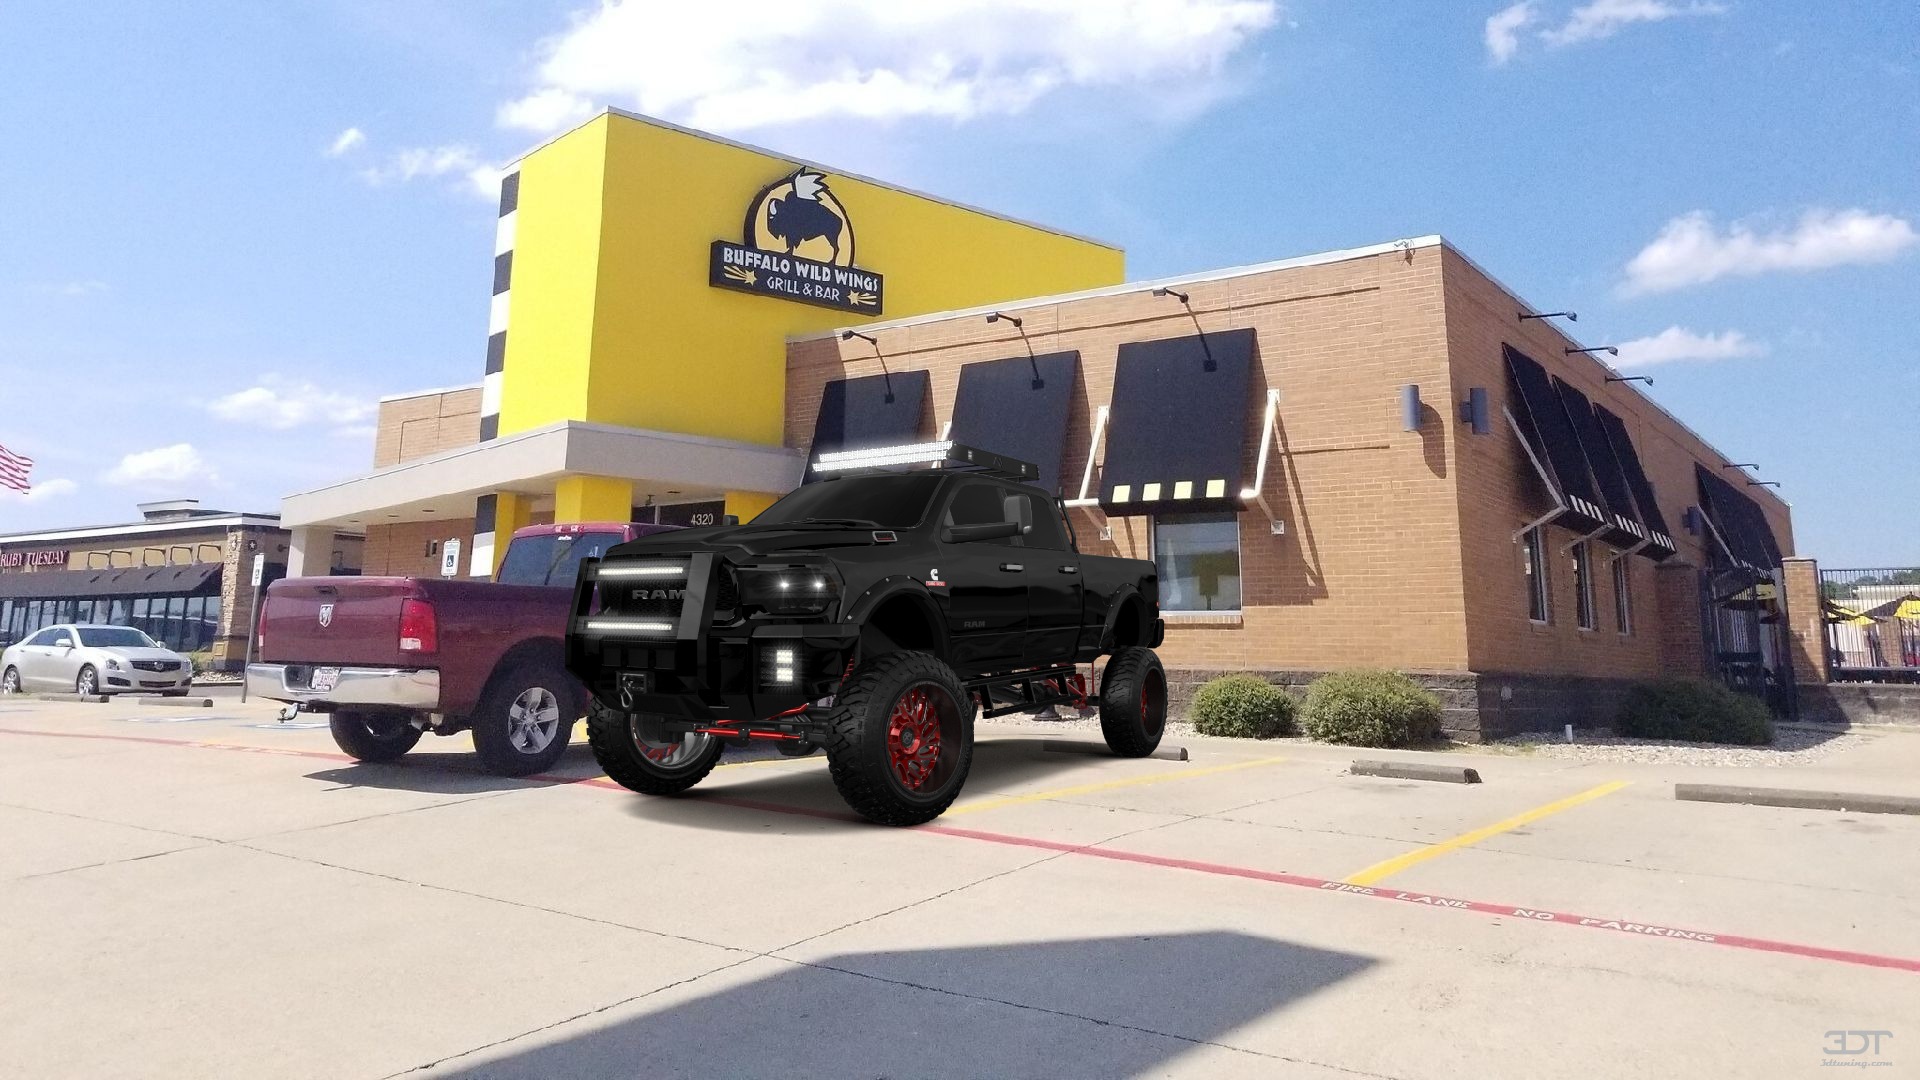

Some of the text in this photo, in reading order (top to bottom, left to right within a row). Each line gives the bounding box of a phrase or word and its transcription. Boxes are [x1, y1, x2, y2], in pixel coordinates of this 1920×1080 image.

[723, 247, 878, 292] BUFFALO WILD WINGS
[766, 276, 840, 301] GRILL & BAR
[690, 513, 714, 526] 4320
[0, 550, 67, 567] RUBY TUESDAY
[632, 589, 686, 600] RAM
[964, 620, 986, 628] RAM
[1320, 881, 1716, 943] FIRE LANE NO PARKING
